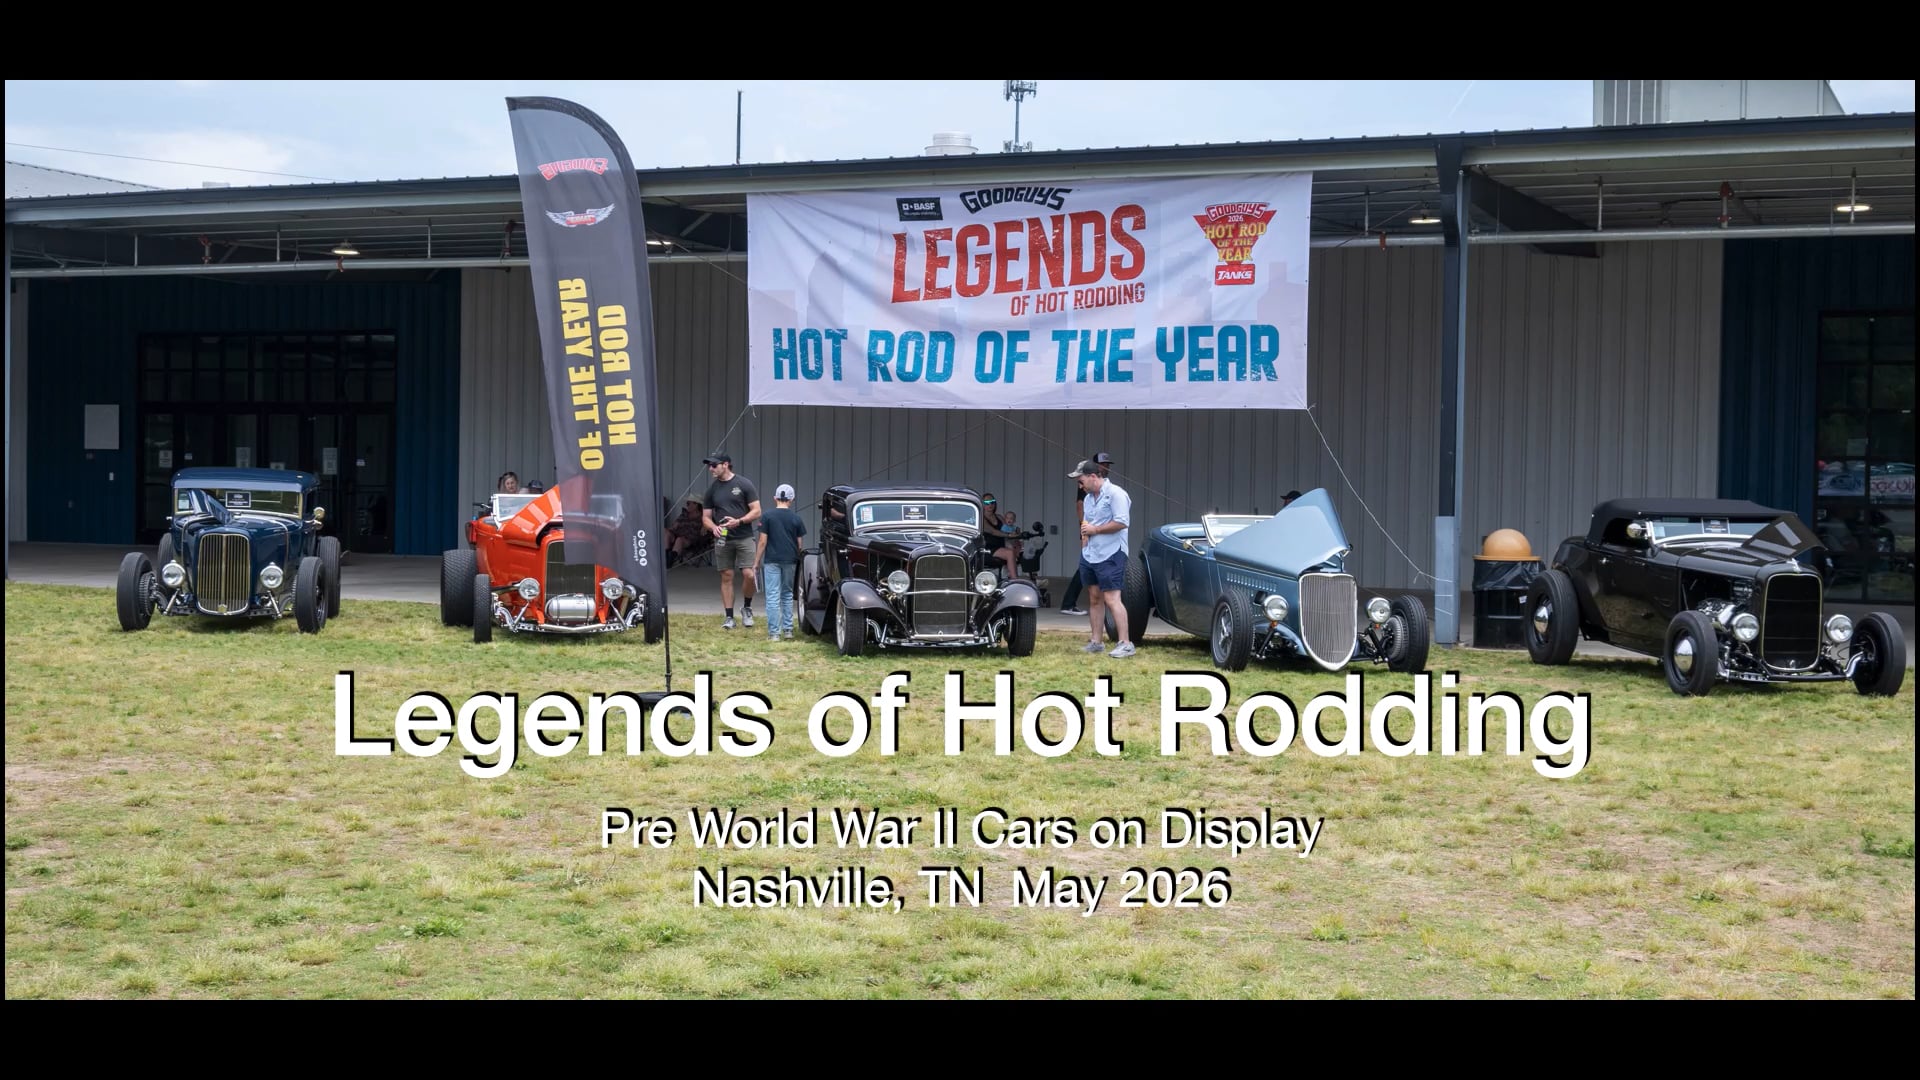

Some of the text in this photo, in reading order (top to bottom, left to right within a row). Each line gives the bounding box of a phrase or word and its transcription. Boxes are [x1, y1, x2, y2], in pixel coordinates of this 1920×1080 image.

[913, 202, 936, 211] BASF
[960, 186, 1072, 214] GOODGUYS
[1205, 202, 1269, 221] GOODGUYS
[1204, 221, 1267, 239] HOT ROD
[1217, 238, 1254, 248] OF THE
[891, 204, 1146, 303] LEGENDS
[1217, 247, 1253, 262] YEAR
[1216, 270, 1253, 281] TANKS
[1010, 282, 1146, 317] OF HOT RODDING
[772, 324, 1281, 384] HOT ROD OF THE YEAR
